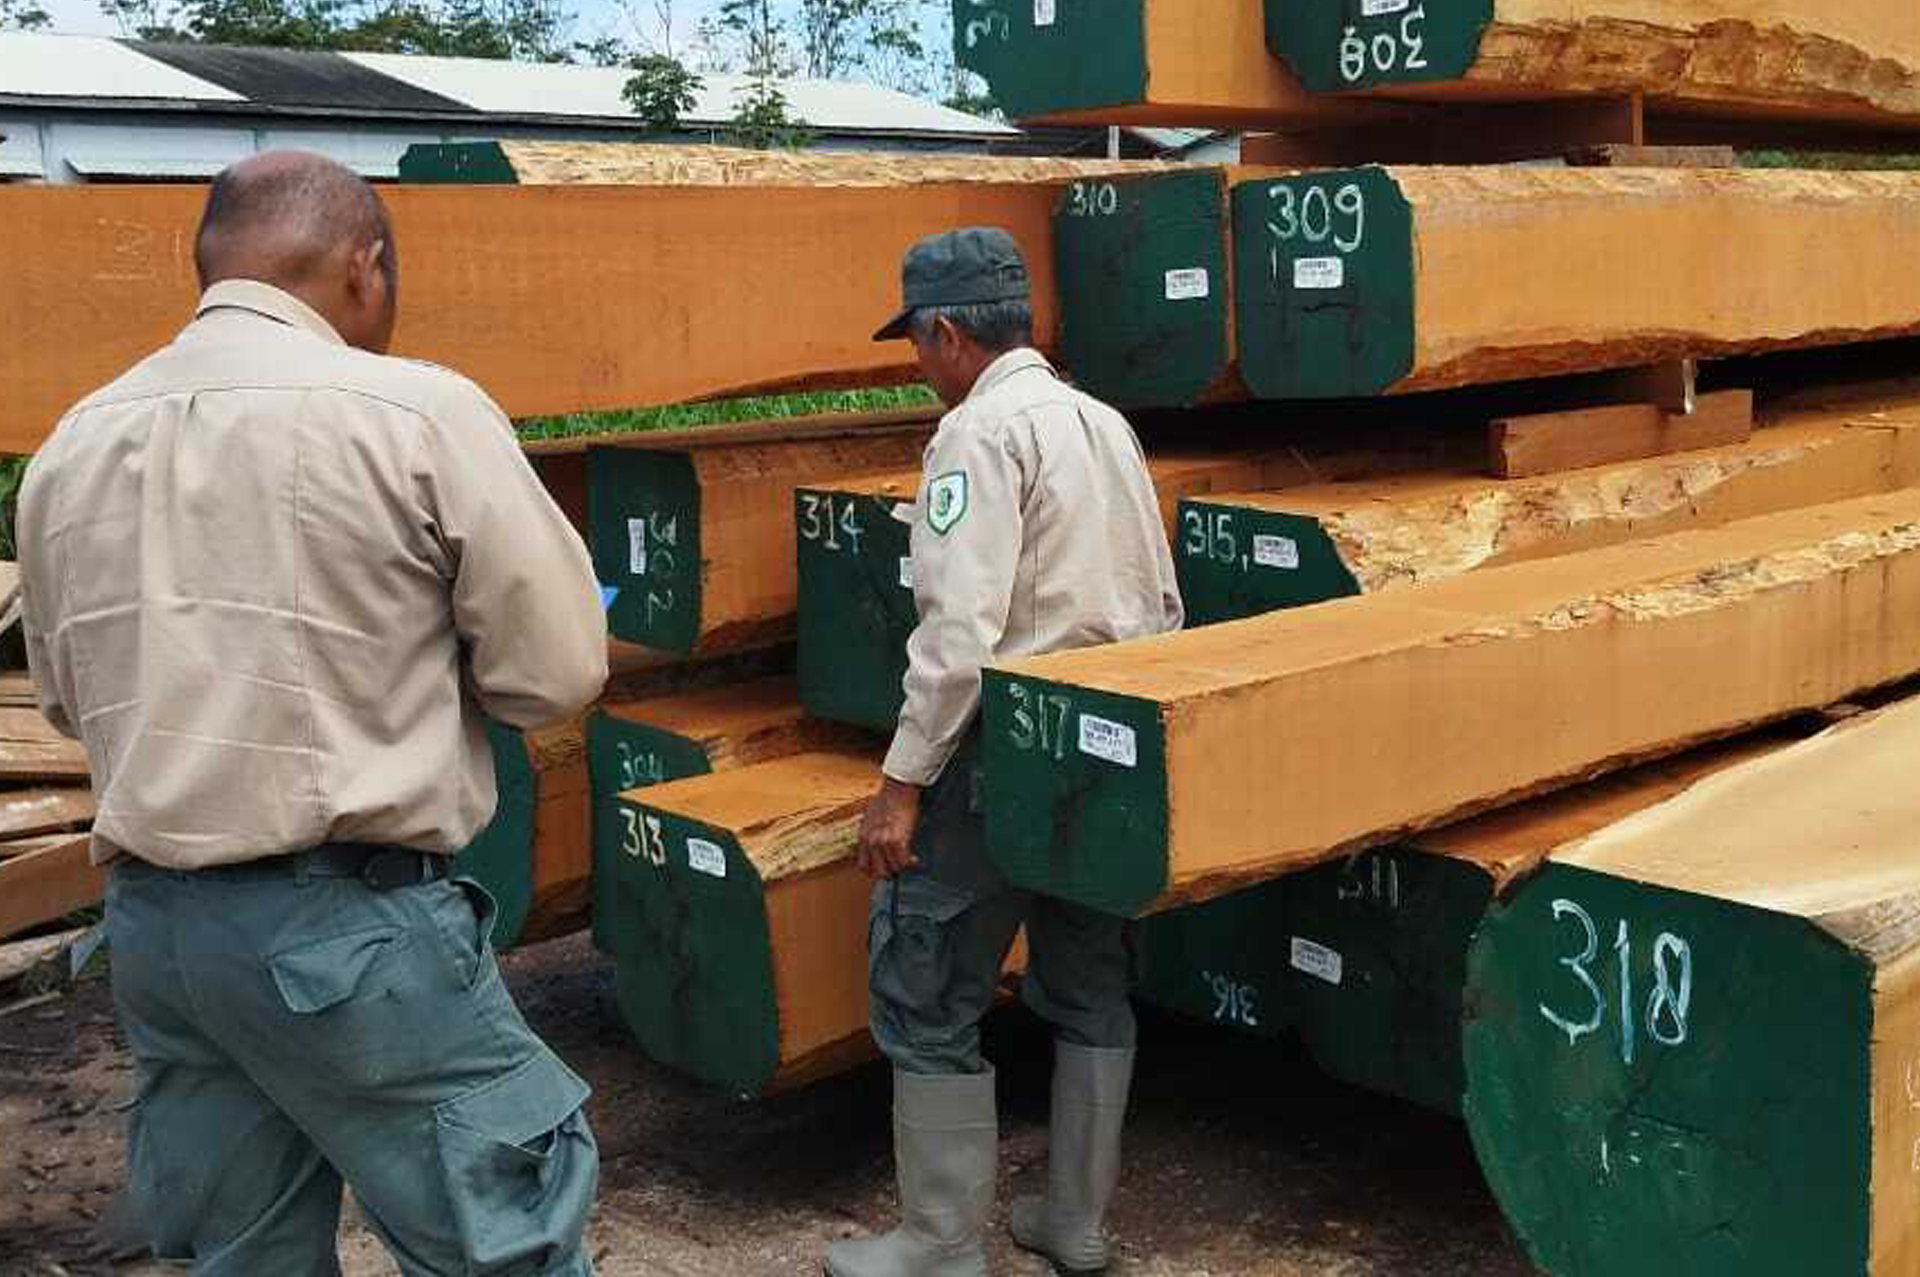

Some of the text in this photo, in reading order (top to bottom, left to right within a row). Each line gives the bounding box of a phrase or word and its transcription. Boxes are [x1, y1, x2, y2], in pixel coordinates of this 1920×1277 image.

[1340, 7, 1427, 81] 308
[1069, 182, 1118, 216] 310
[1267, 184, 1364, 252] 309
[801, 495, 864, 554] 314
[1009, 683, 1071, 760] 317
[619, 807, 667, 865] 313
[1540, 899, 1691, 1064] 318
